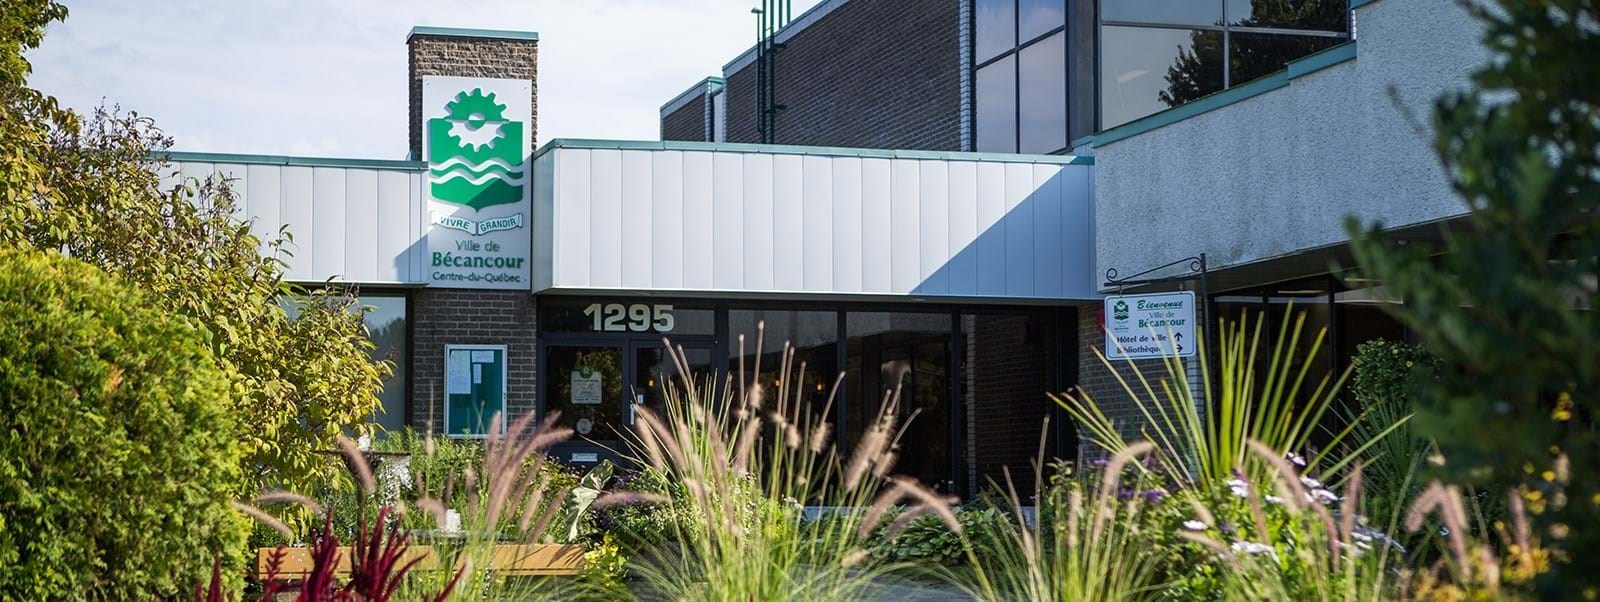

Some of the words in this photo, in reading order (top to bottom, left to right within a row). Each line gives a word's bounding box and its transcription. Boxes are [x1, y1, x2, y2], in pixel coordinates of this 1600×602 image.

[441, 216, 470, 230] VIVRE
[480, 217, 517, 232] GRANDIR
[455, 240, 480, 252] Ville
[484, 240, 500, 252] de
[431, 251, 524, 269] Bécancour
[432, 271, 521, 283] Centre-du-Québec
[1136, 299, 1184, 309] Bienvenue
[583, 303, 675, 332] 1295
[1149, 311, 1164, 319] Ville
[1116, 335, 1137, 344] Hôtel
